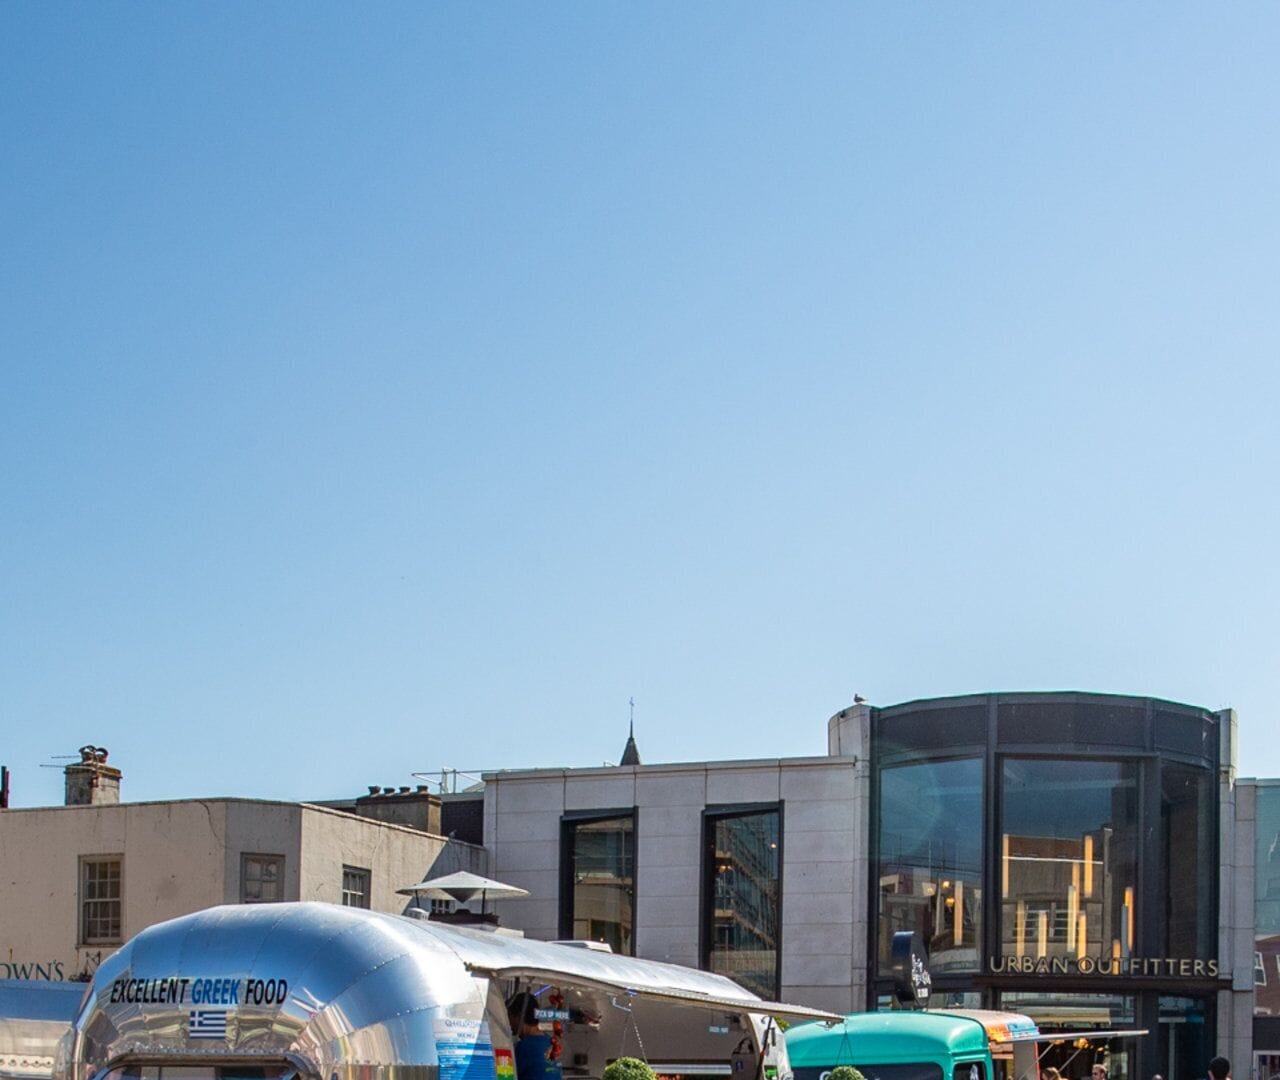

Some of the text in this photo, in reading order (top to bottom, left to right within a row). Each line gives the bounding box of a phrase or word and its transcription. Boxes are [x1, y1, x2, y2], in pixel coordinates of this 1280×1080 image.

[989, 956, 1219, 977] URBAN OUTFITTERS
[110, 978, 288, 1006] EXCELLENT GREEK FOOD
